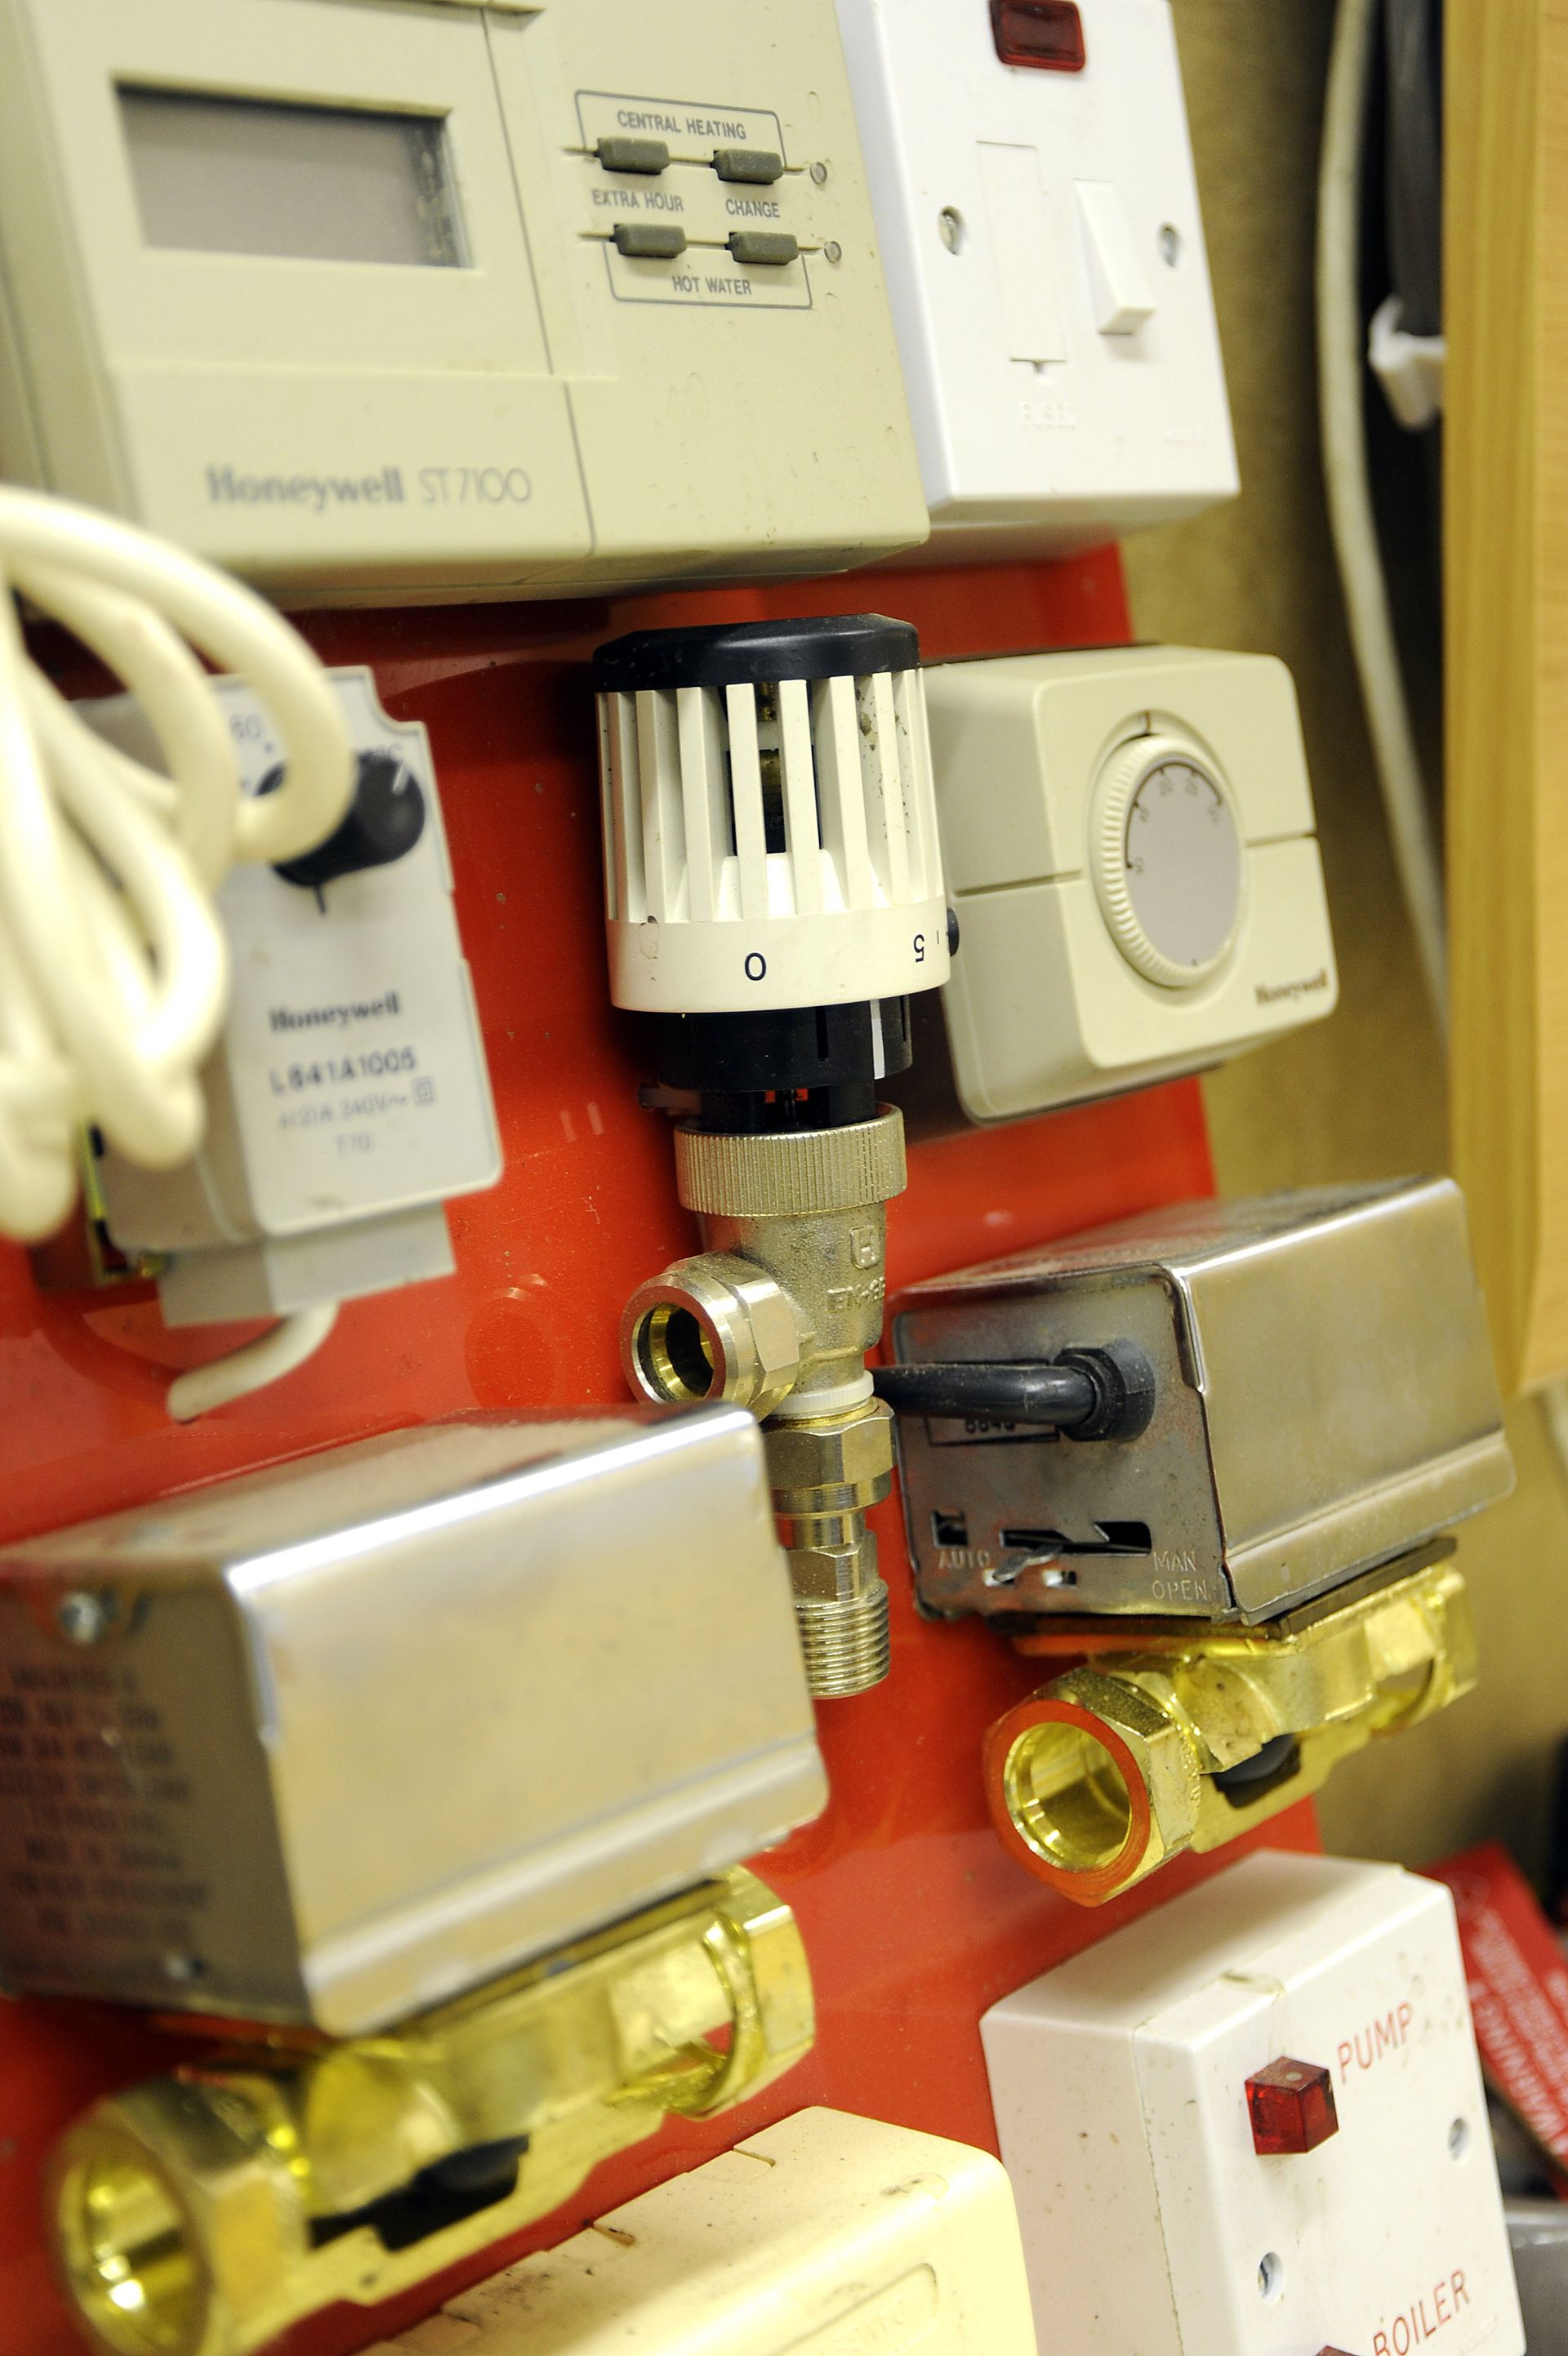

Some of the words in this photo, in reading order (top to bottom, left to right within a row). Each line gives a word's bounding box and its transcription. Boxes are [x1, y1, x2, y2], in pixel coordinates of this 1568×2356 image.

[617, 109, 682, 133] CENTRAL
[686, 118, 746, 140] HEATING
[592, 188, 639, 209] EXTRA
[644, 192, 684, 212] HOUR
[725, 198, 780, 218] CHANGE
[672, 276, 699, 293] HOT
[706, 277, 751, 295] WATER
[206, 465, 404, 512] Honeywell
[269, 991, 400, 1031] Honeywell
[938, 1550, 990, 1570] AUTO
[1152, 1551, 1196, 1572] MAN
[1152, 1580, 1209, 1601] OPEN
[1337, 2002, 1414, 2083] PUMP
[1373, 2269, 1470, 2356] BOILER
